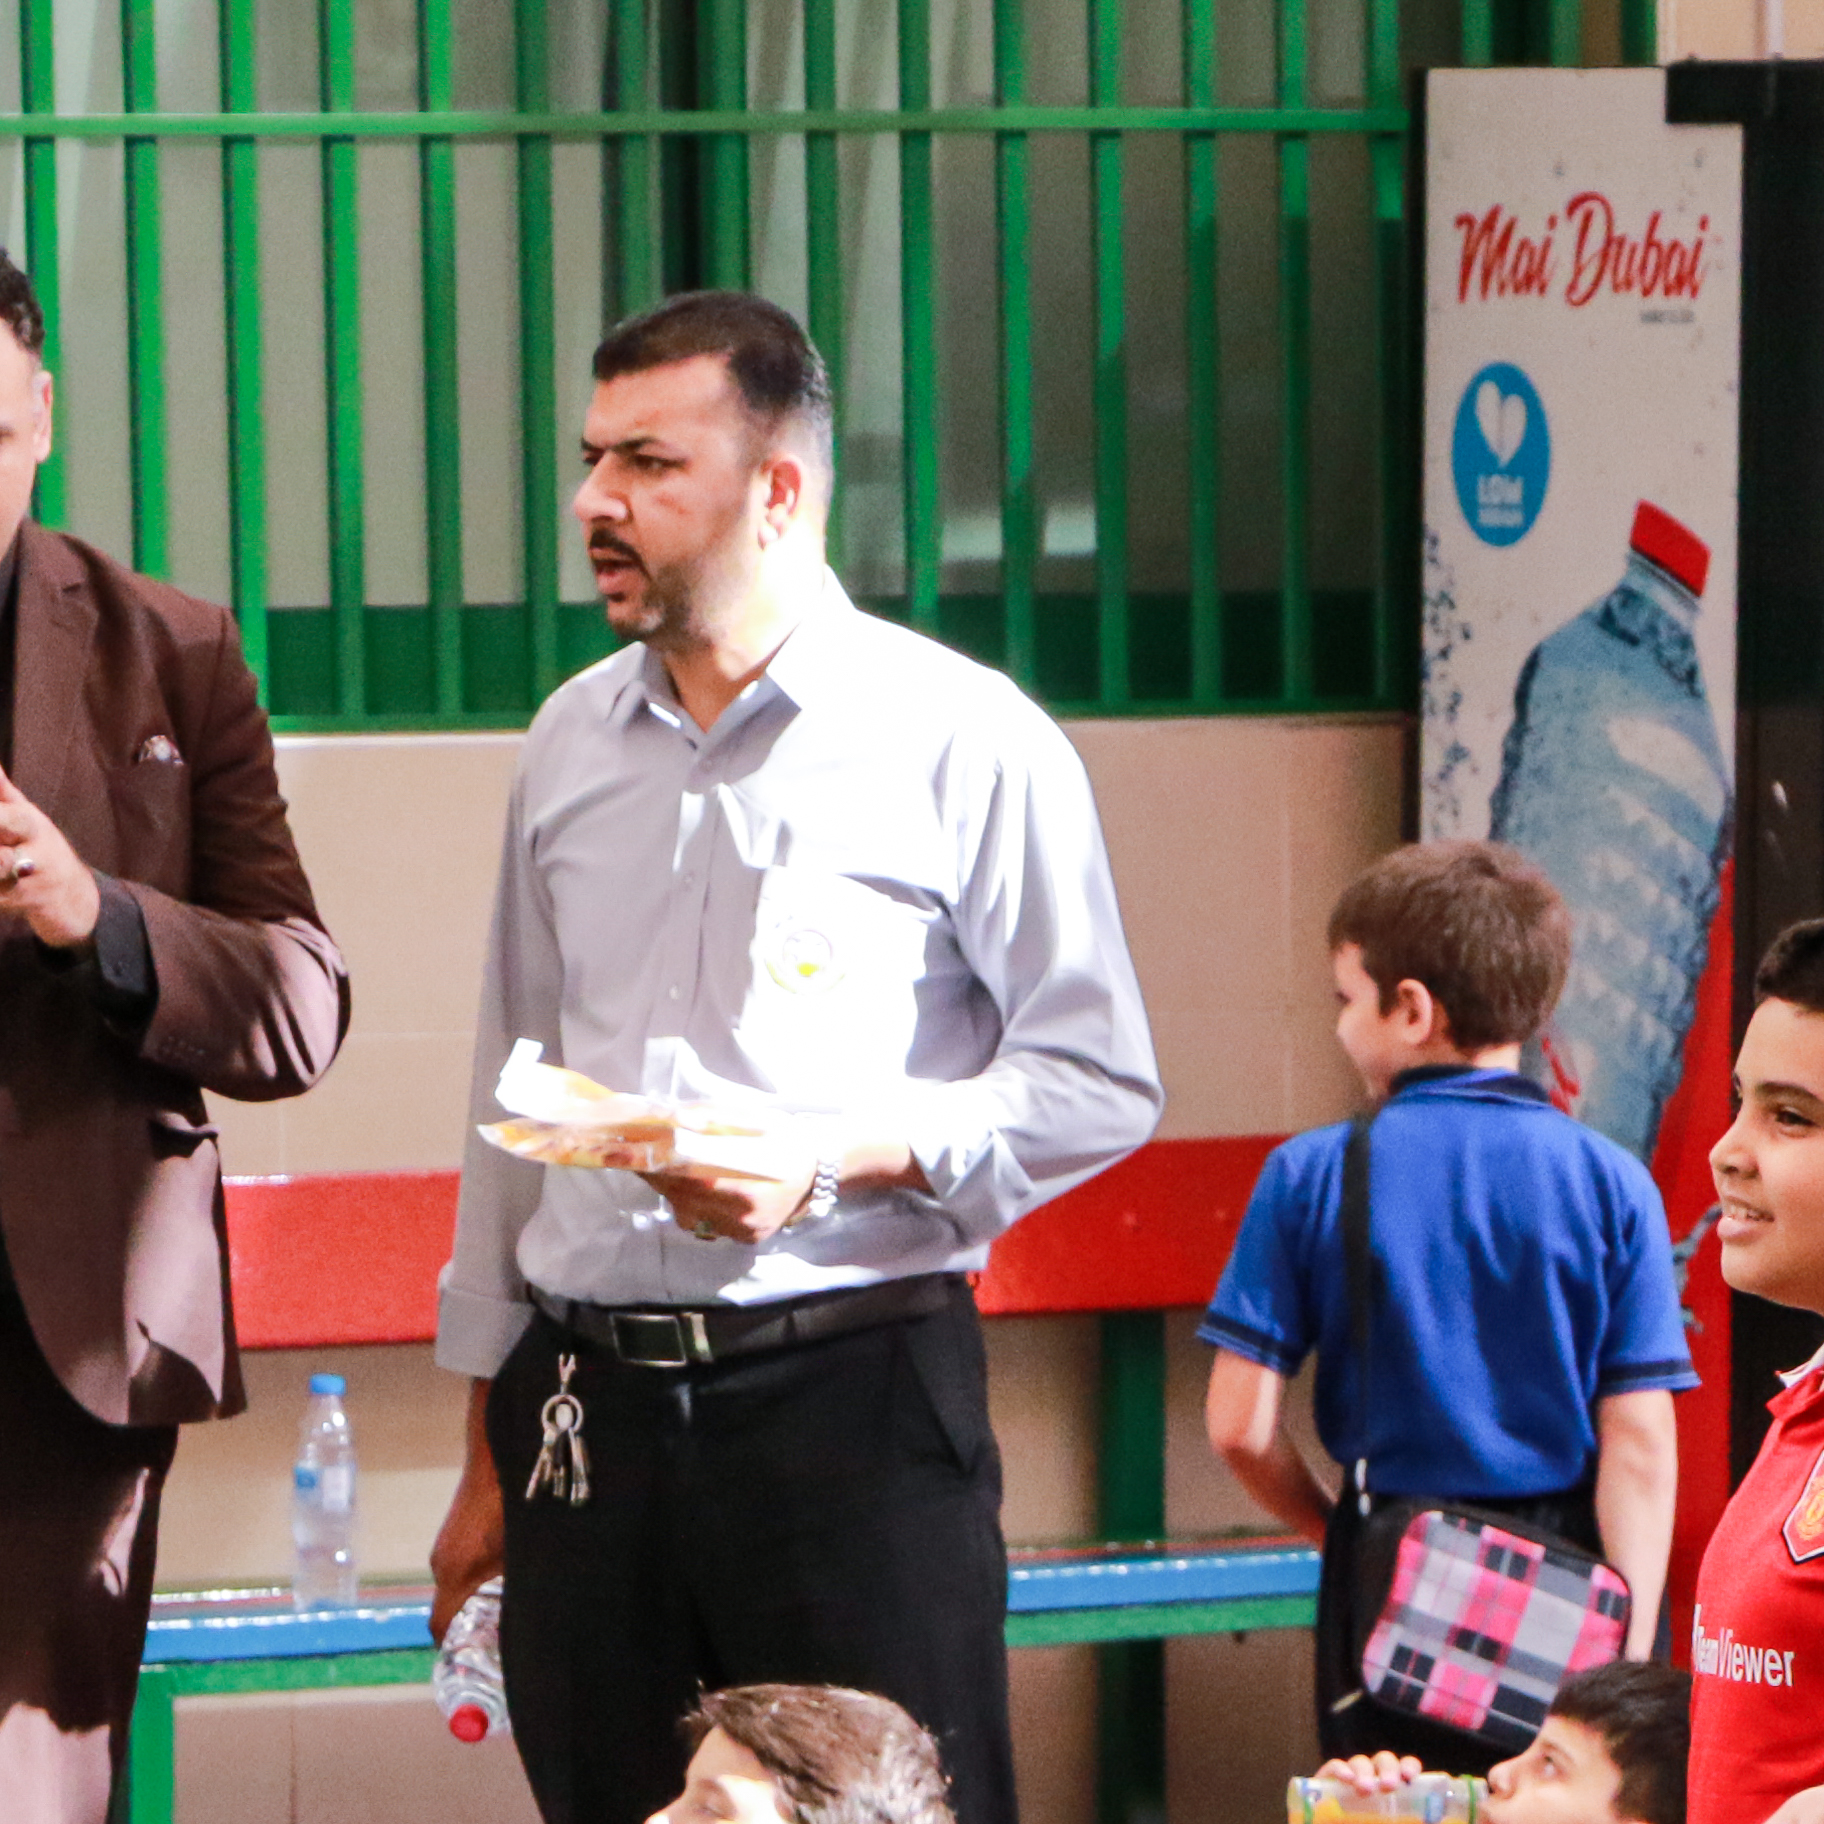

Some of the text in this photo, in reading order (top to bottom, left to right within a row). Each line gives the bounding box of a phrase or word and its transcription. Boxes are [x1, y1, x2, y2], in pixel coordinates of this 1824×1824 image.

[1454, 191, 1710, 308] Mai Dubai
[1477, 474, 1524, 504] LOW
